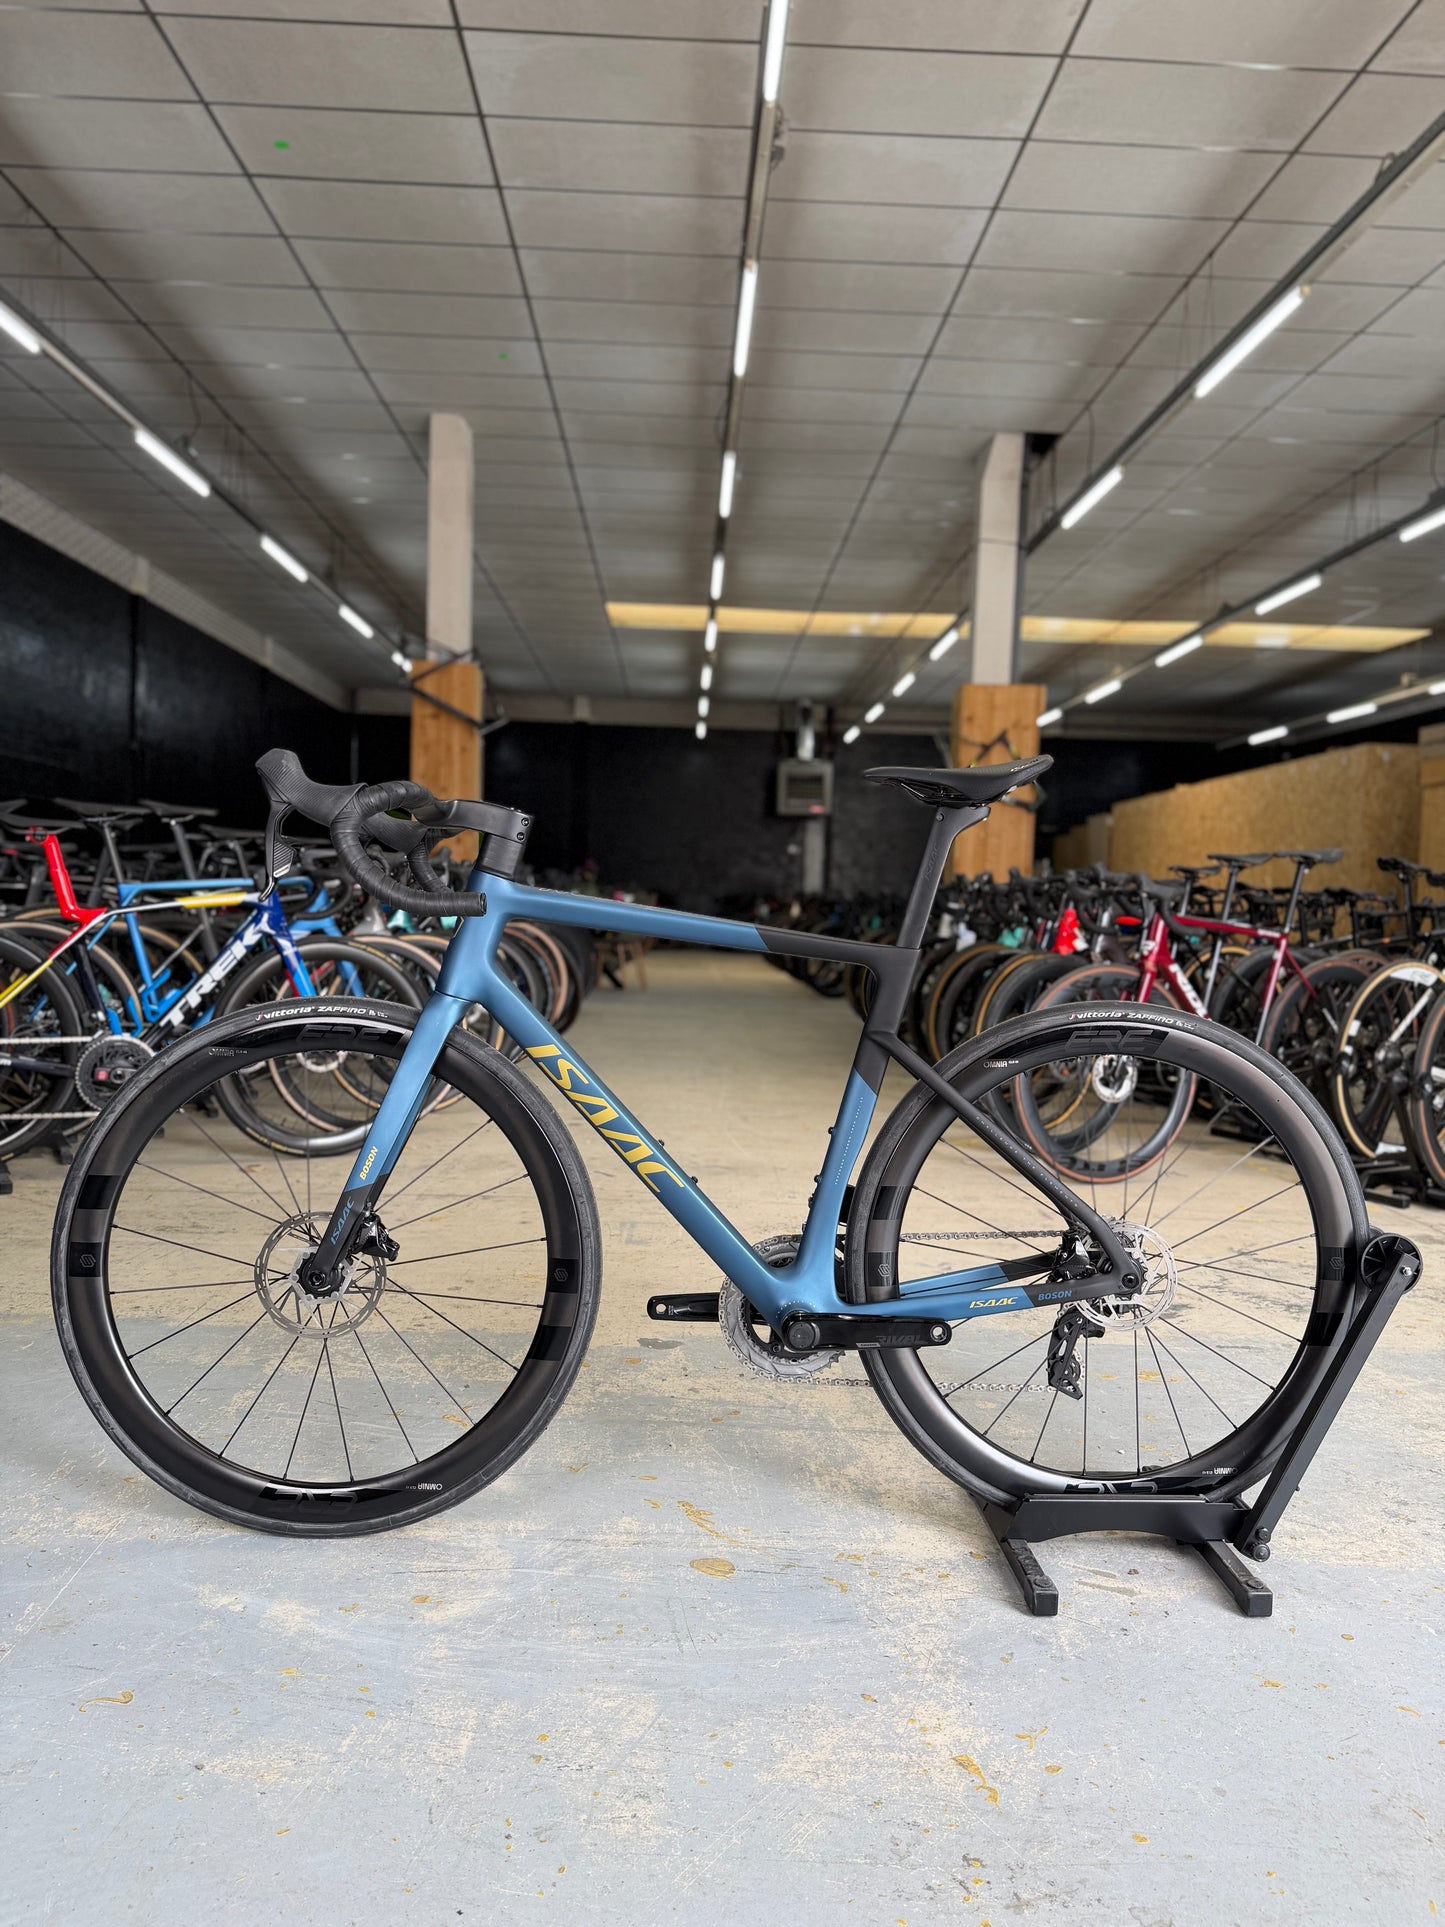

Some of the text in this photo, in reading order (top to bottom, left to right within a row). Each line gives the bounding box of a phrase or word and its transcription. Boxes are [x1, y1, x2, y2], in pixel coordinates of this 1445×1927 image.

[159, 922, 262, 1027] TREK
[263, 1006, 314, 1019] vittoria
[317, 1006, 366, 1014] ZAFFIRO
[1076, 1011, 1123, 1019] vittoria
[1065, 1029, 1154, 1052] ERE
[983, 1060, 1008, 1069] OMNIA
[525, 1044, 684, 1193] ISAAC
[360, 1146, 378, 1181] BOSON
[330, 1196, 354, 1245] ISAAC
[1037, 1290, 1072, 1301] BOSON
[969, 1296, 1019, 1309] ISAAC
[417, 1482, 442, 1491] OMNIA
